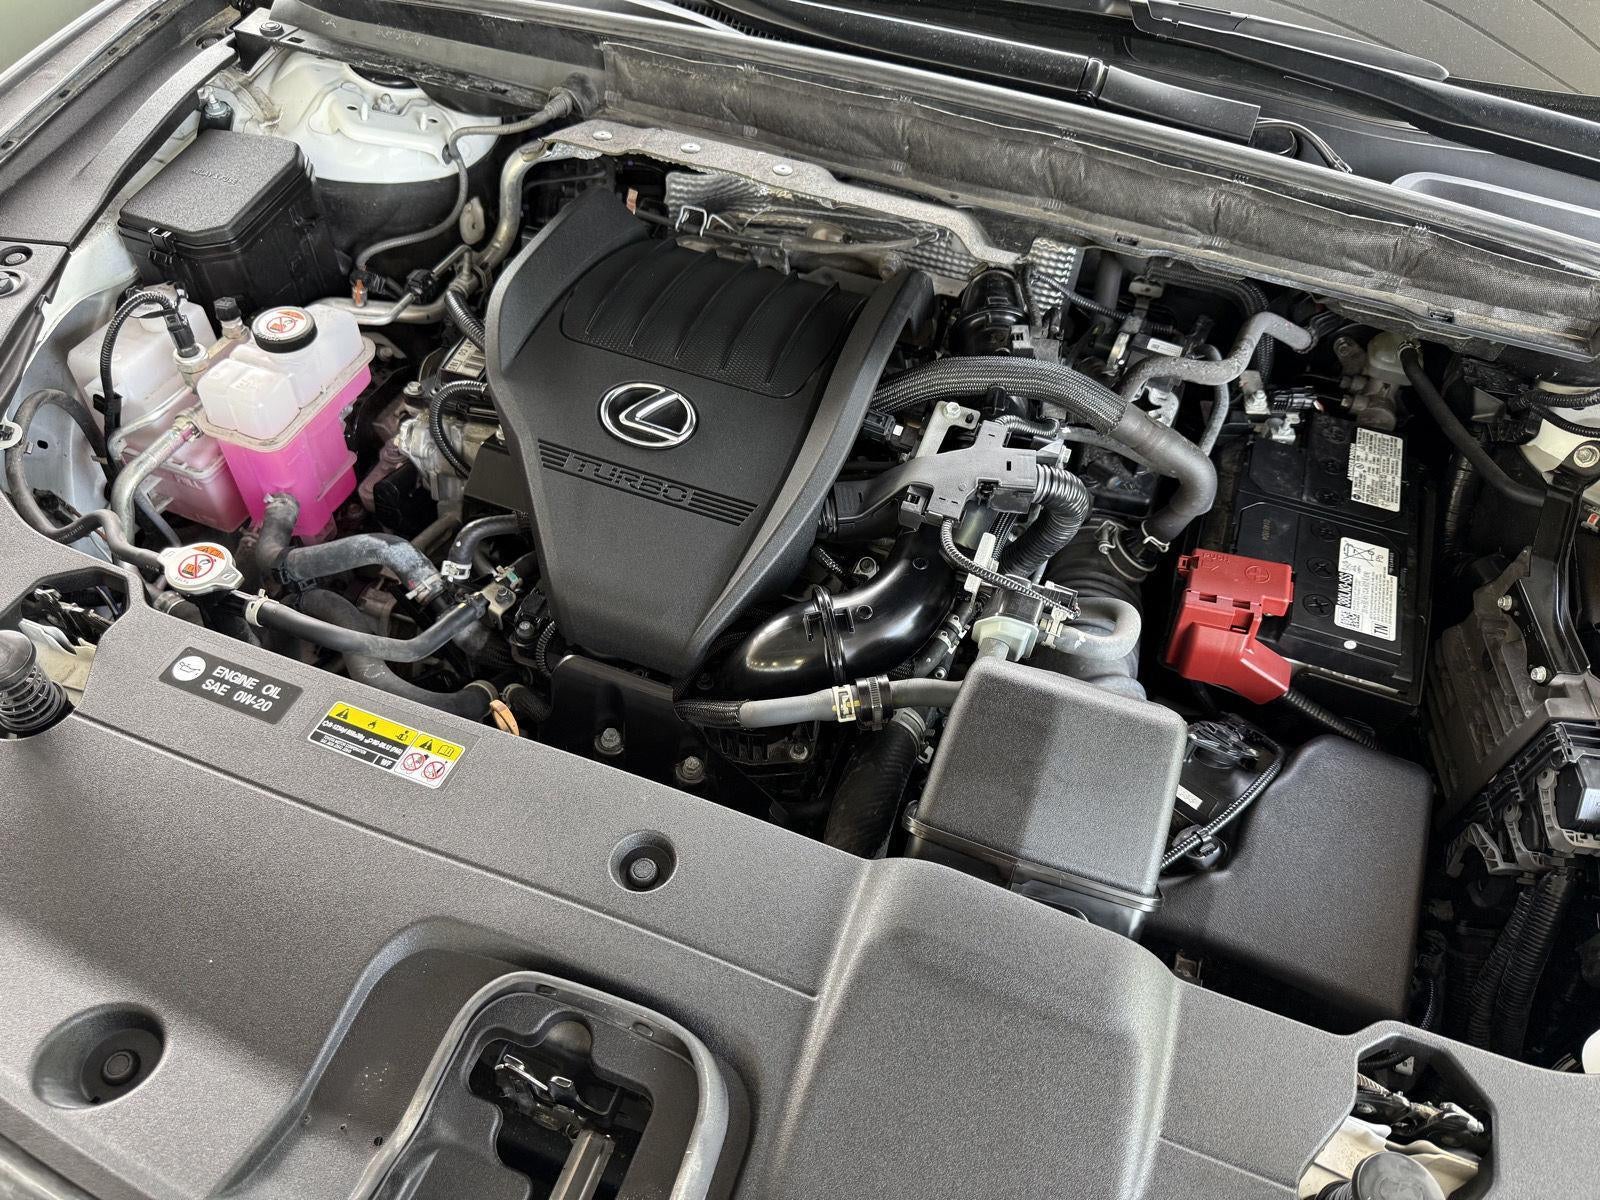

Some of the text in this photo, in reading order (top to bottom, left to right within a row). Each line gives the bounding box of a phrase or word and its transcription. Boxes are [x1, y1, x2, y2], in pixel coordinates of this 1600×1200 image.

[564, 451, 694, 503] TURBO
[1373, 623, 1389, 636] TN
[201, 679, 273, 712] SAE 0W-20
[212, 665, 282, 700] ENGINE OIL
